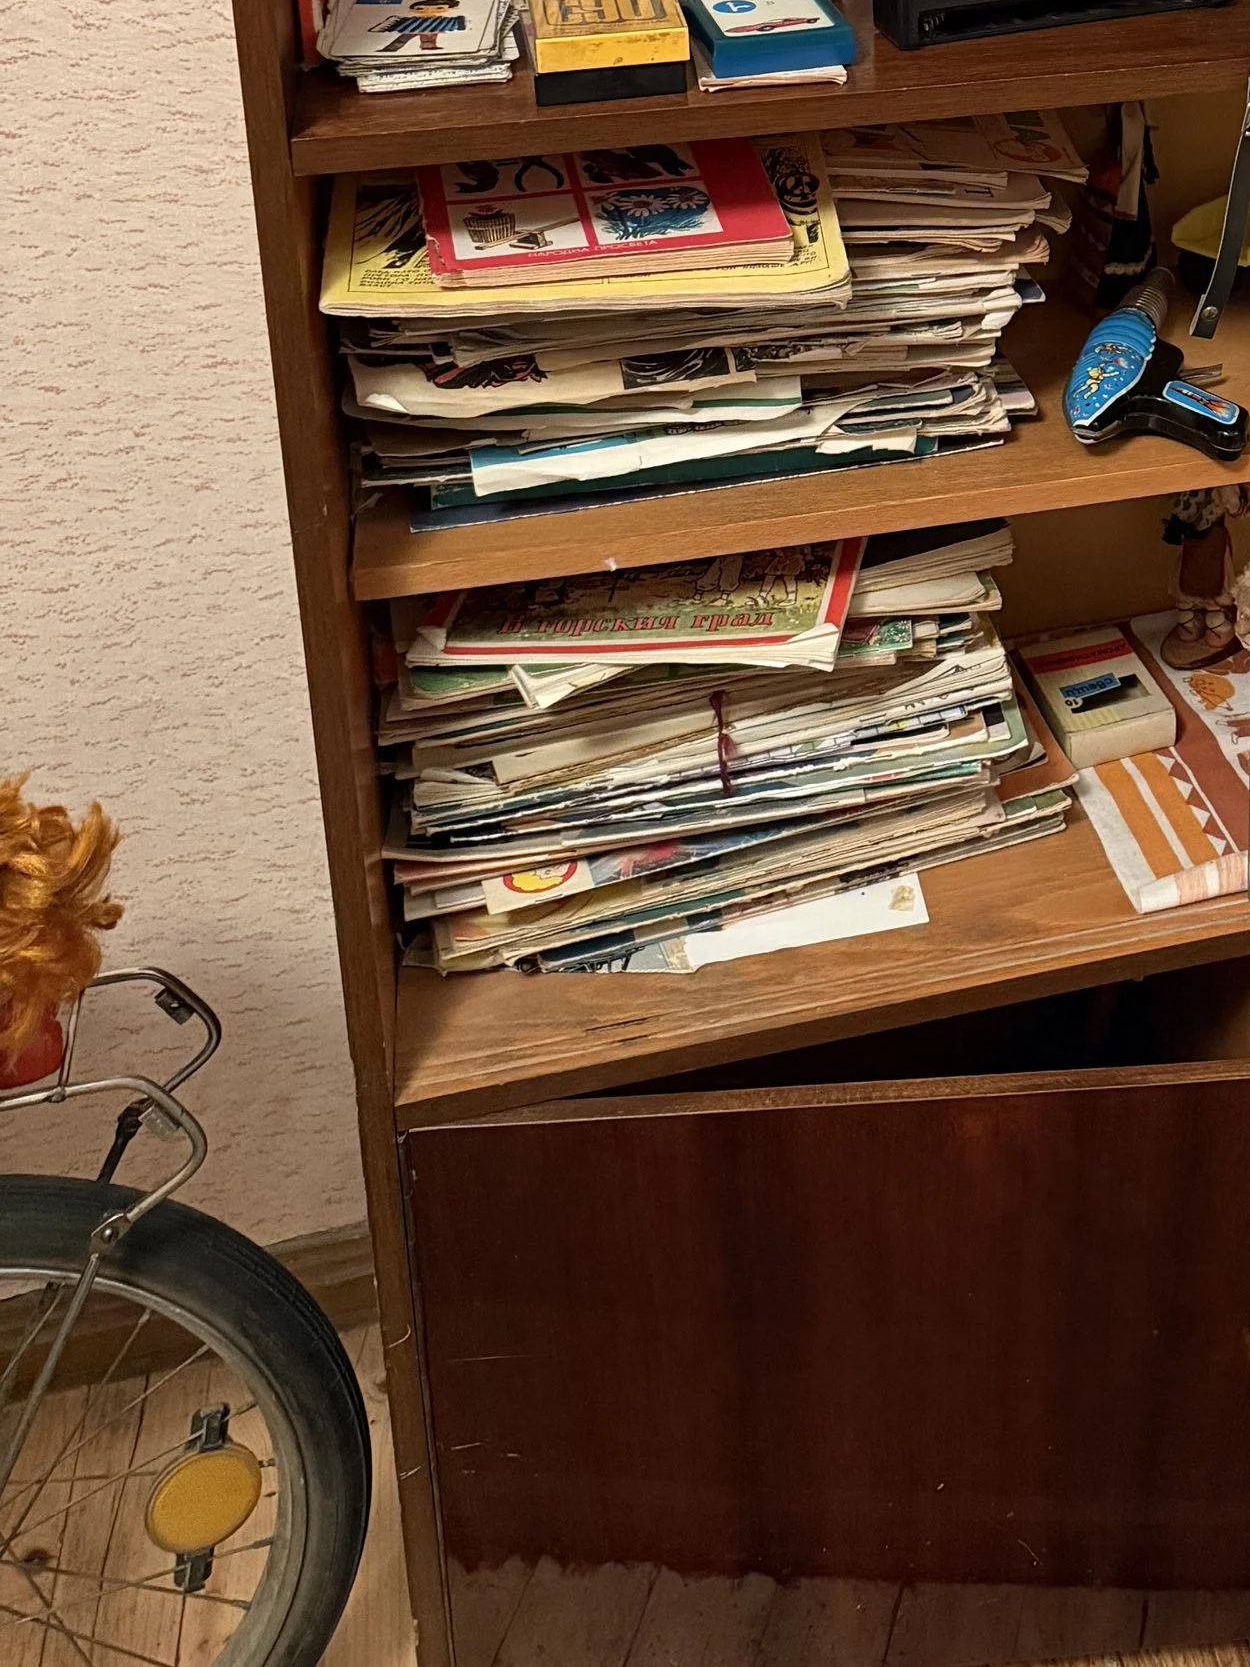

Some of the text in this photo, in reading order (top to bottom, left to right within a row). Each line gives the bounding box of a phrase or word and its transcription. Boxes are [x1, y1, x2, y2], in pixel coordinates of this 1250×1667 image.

[594, 239, 658, 252] ПРОСВЕТА
[691, 612, 776, 633] град
[1064, 677, 1114, 696] свещи
